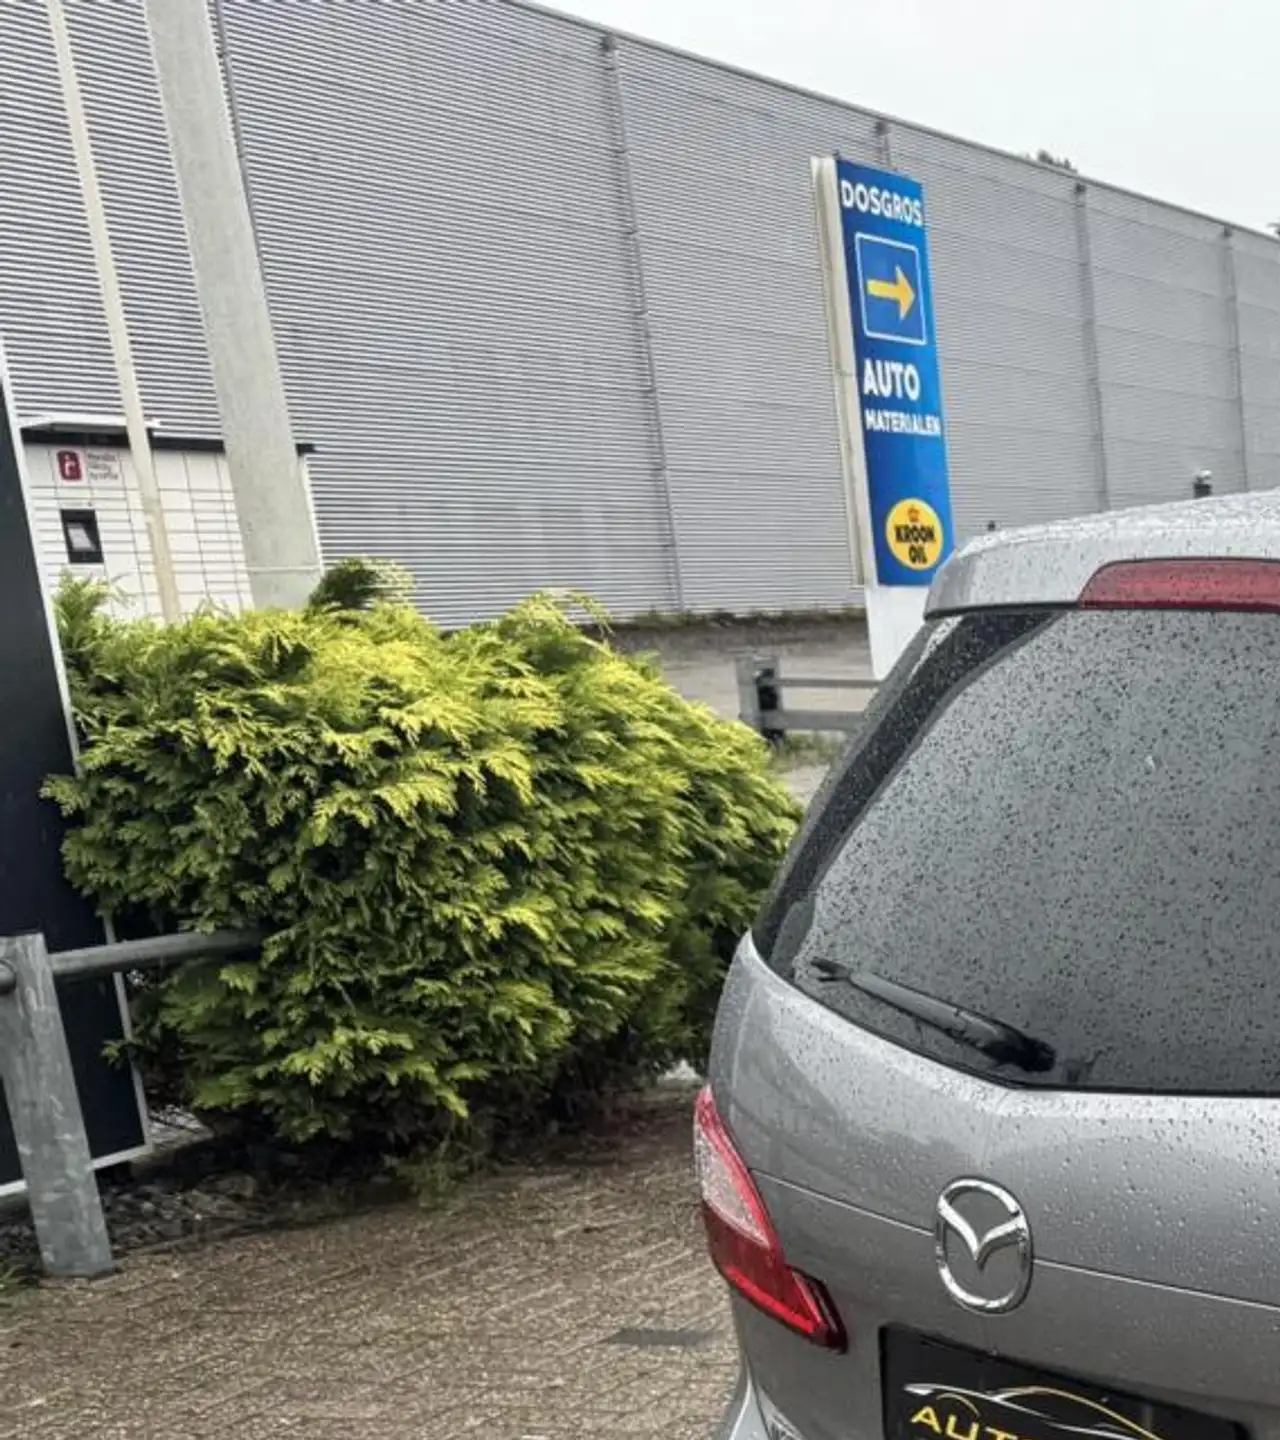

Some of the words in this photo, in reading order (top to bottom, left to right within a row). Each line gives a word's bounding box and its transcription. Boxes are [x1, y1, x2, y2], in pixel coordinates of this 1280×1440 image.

[841, 178, 924, 228] DOSGROS
[863, 359, 920, 401] AUTO
[864, 409, 941, 437] MATERIALEN
[894, 524, 936, 546] KROON
[908, 543, 928, 565] OIL
